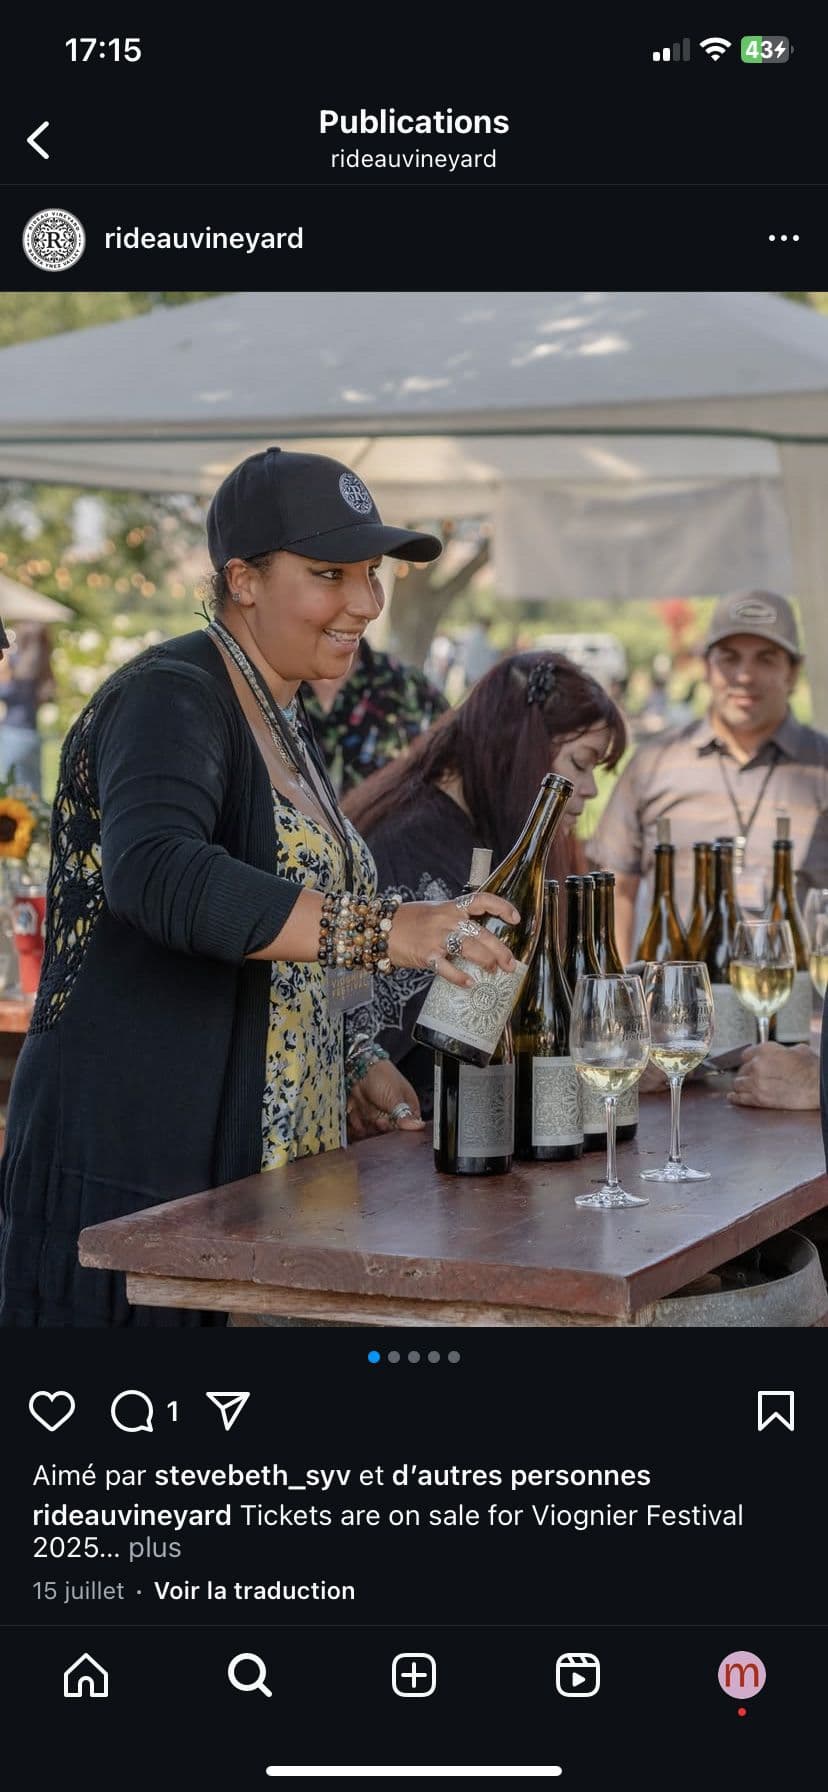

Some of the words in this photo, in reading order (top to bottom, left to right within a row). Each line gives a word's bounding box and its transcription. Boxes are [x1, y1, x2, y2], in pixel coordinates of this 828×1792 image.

[65, 37, 142, 63] 17:15
[745, 40, 773, 59] 43
[319, 107, 510, 135] Publications
[331, 148, 497, 173] rideauvineyard
[45, 231, 62, 249] R
[105, 225, 303, 254] rideauvineyard
[166, 1400, 178, 1422] 1
[32, 1462, 97, 1486] Aimé
[105, 1469, 147, 1491] par
[154, 1463, 352, 1492] stevebeth_syv
[359, 1465, 385, 1486] et
[392, 1463, 503, 1487] d’autres
[511, 1469, 651, 1491] personnes
[33, 1502, 231, 1532] rideauvineyard
[239, 1503, 332, 1526] Tickets
[340, 1509, 381, 1526] are
[388, 1509, 420, 1526] on
[428, 1503, 480, 1526] sale
[487, 1503, 524, 1526] for
[531, 1503, 639, 1531] Viognier
[647, 1503, 743, 1526] Festival
[129, 1535, 182, 1563] plus
[32, 1581, 57, 1600] 15
[63, 1580, 125, 1604] juillet
[153, 1579, 201, 1600] Voir
[207, 1580, 227, 1600] la
[233, 1579, 355, 1600] traduction
[725, 1663, 759, 1688] m
